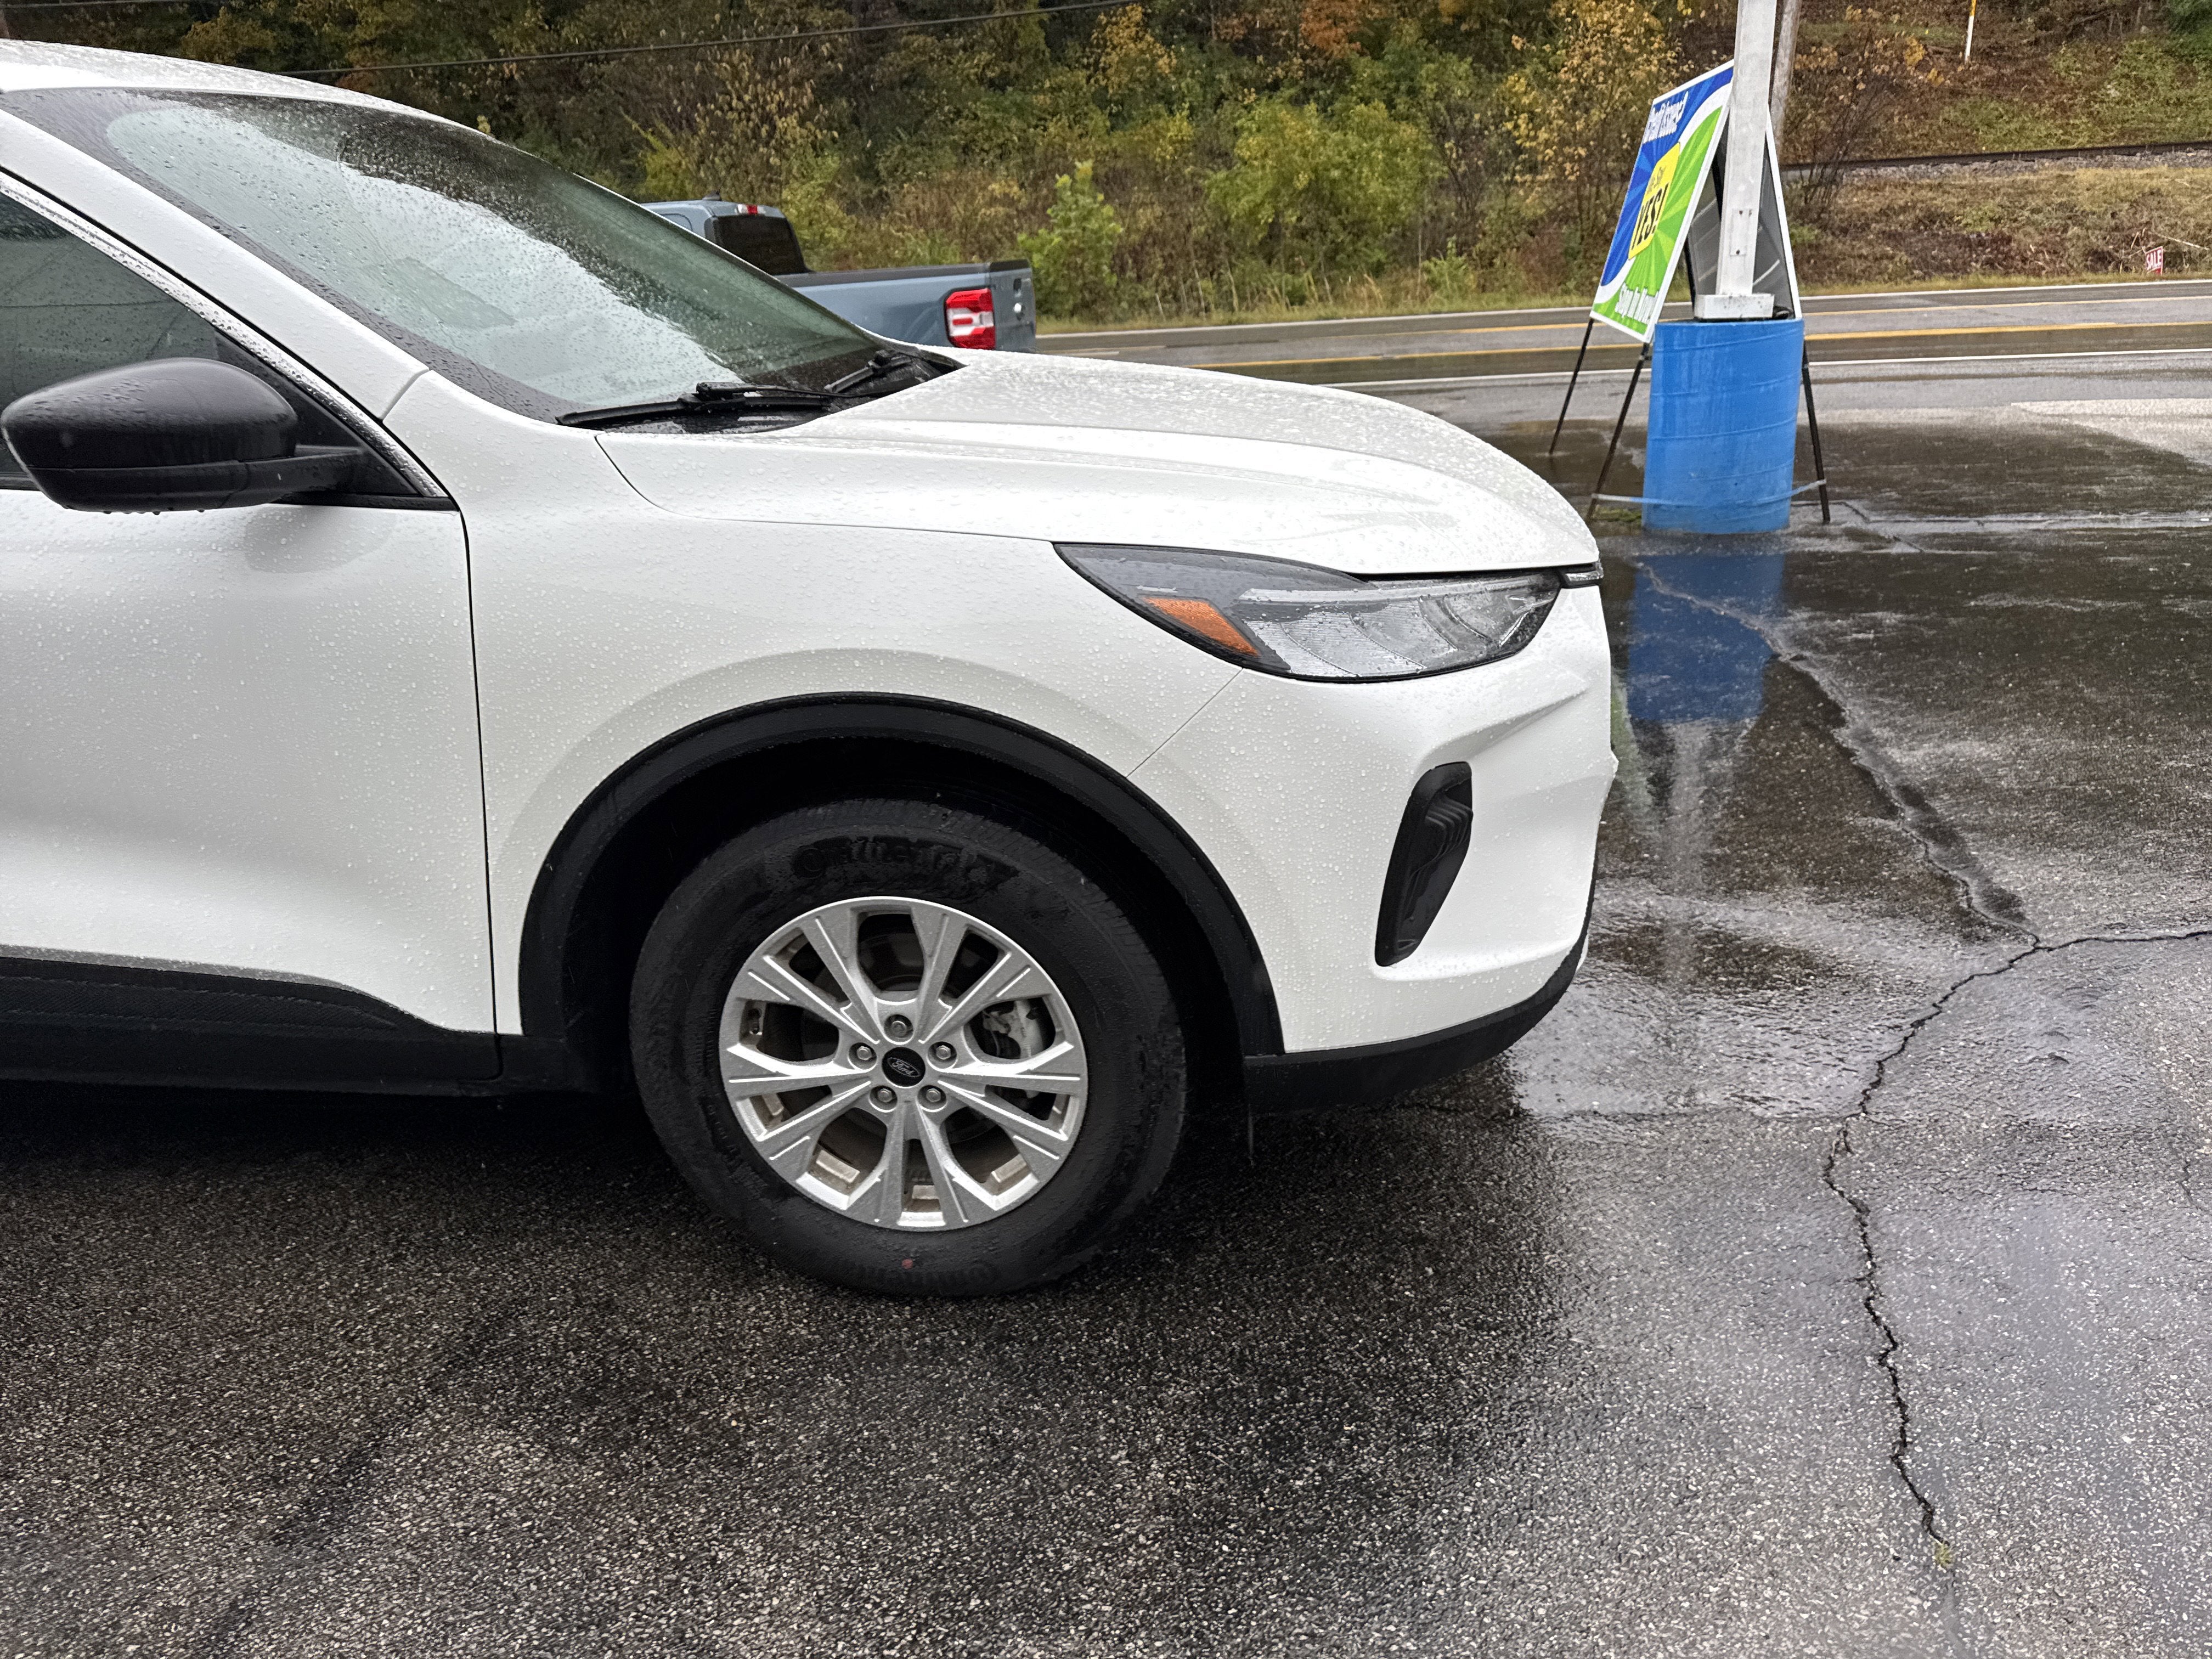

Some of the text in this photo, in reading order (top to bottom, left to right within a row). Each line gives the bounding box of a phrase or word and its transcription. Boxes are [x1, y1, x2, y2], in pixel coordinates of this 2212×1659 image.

[1631, 182, 1669, 250] YES!
[2146, 249, 2162, 270] SALE
[892, 1060, 916, 1075] Ford
